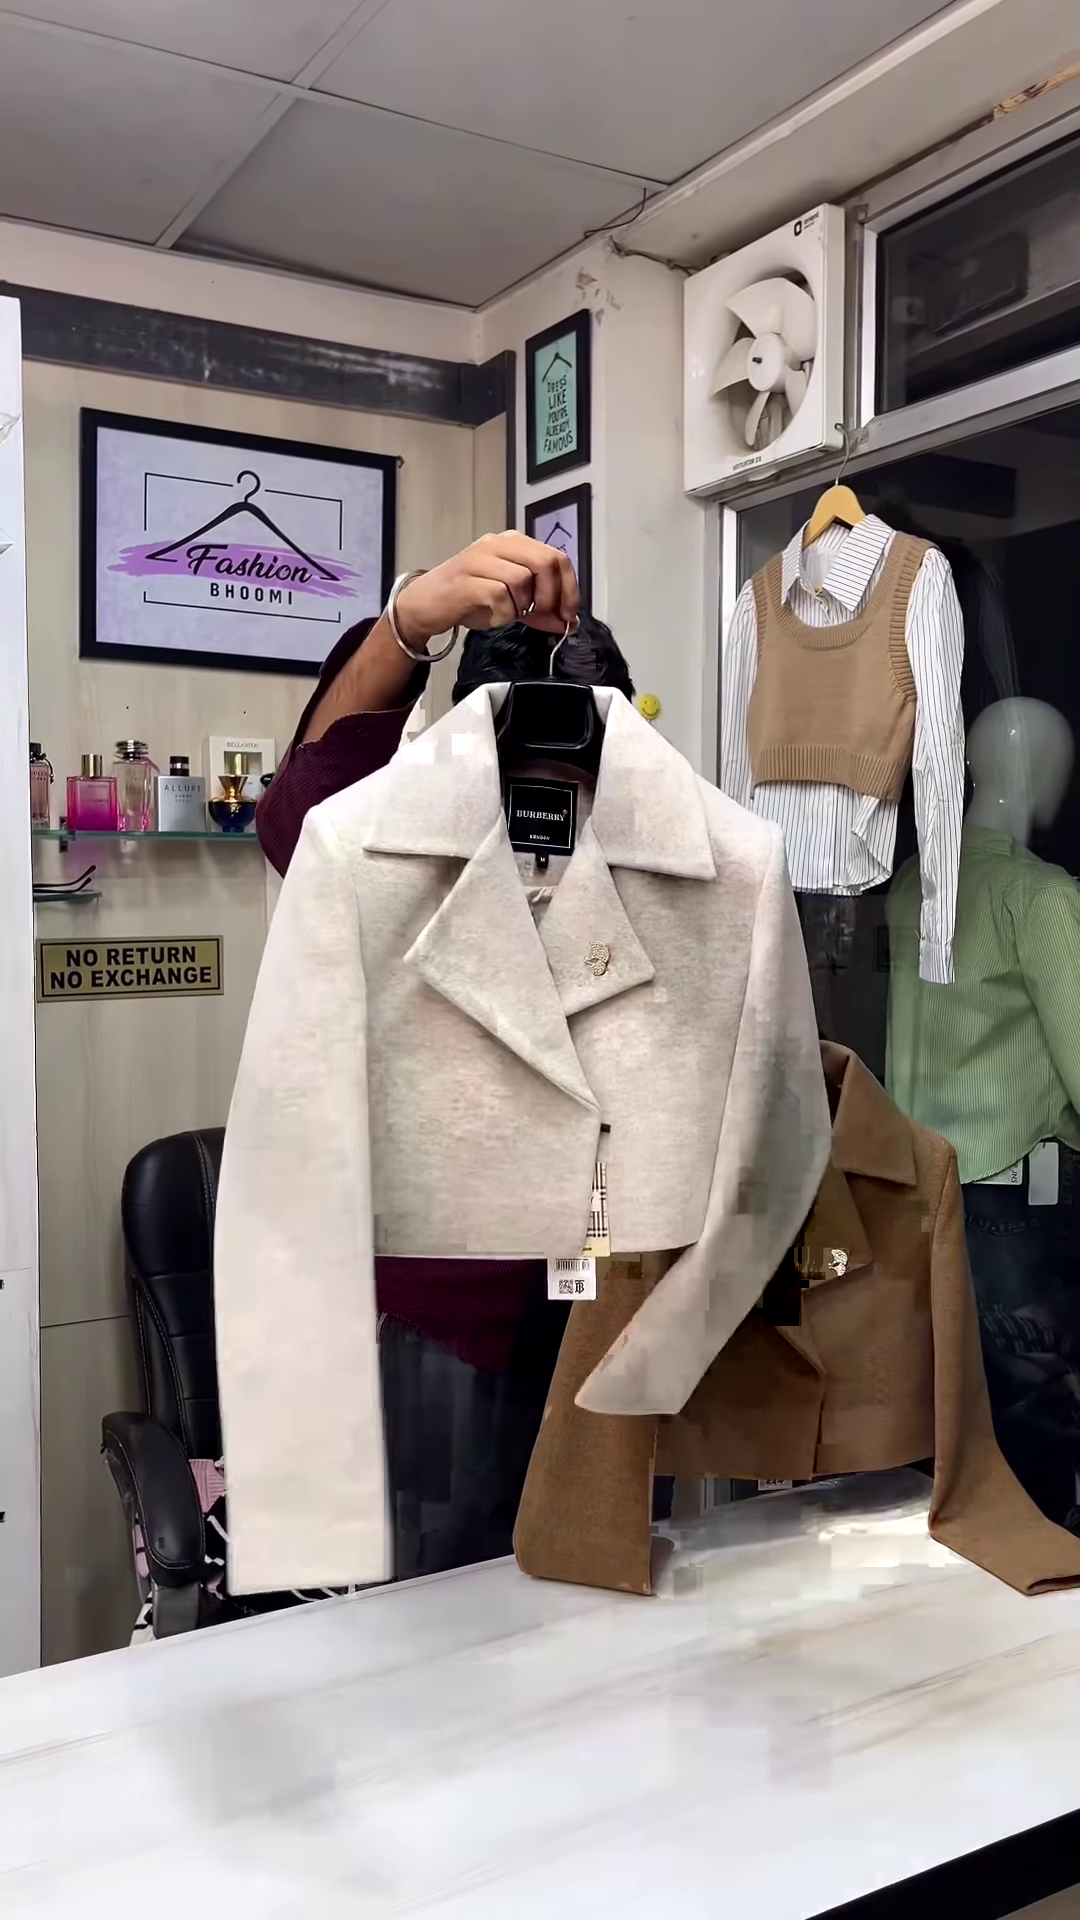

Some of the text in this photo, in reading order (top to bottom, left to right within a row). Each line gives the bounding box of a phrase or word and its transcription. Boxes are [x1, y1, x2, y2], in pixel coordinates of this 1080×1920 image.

[547, 374, 567, 393] DRESS
[548, 388, 567, 410] LIKE
[546, 418, 570, 437] ALREADY
[543, 430, 574, 453] FAMOUS
[186, 544, 313, 583] Fashion
[210, 582, 293, 605] BHOOMI
[164, 784, 201, 793] ALLURE
[516, 809, 565, 822] BURBERRY
[66, 946, 196, 967] NO RETURN
[50, 966, 212, 990] NO EXCHANGE
